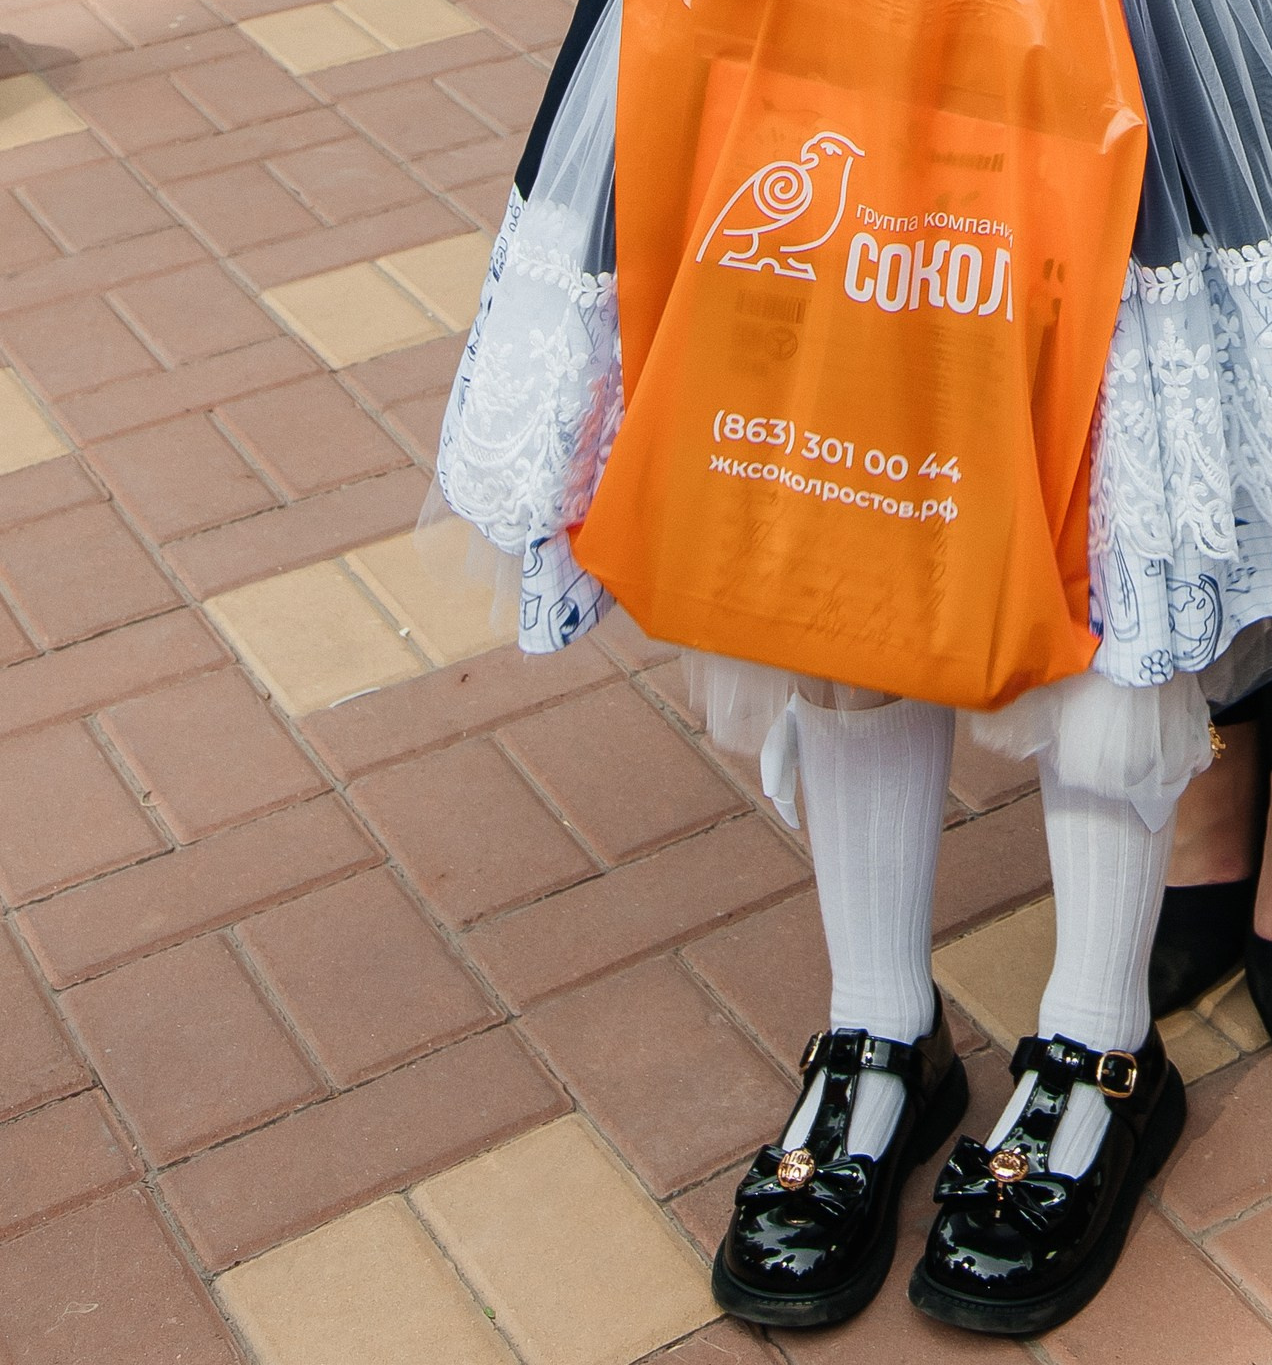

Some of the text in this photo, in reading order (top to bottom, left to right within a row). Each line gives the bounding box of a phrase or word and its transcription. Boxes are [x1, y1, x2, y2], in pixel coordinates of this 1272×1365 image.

[856, 203, 919, 233] группа
[843, 234, 1014, 322] СОКОЛ
[712, 409, 963, 486] (863) 301 00 44
[708, 454, 959, 523] жксоколростов.рф
